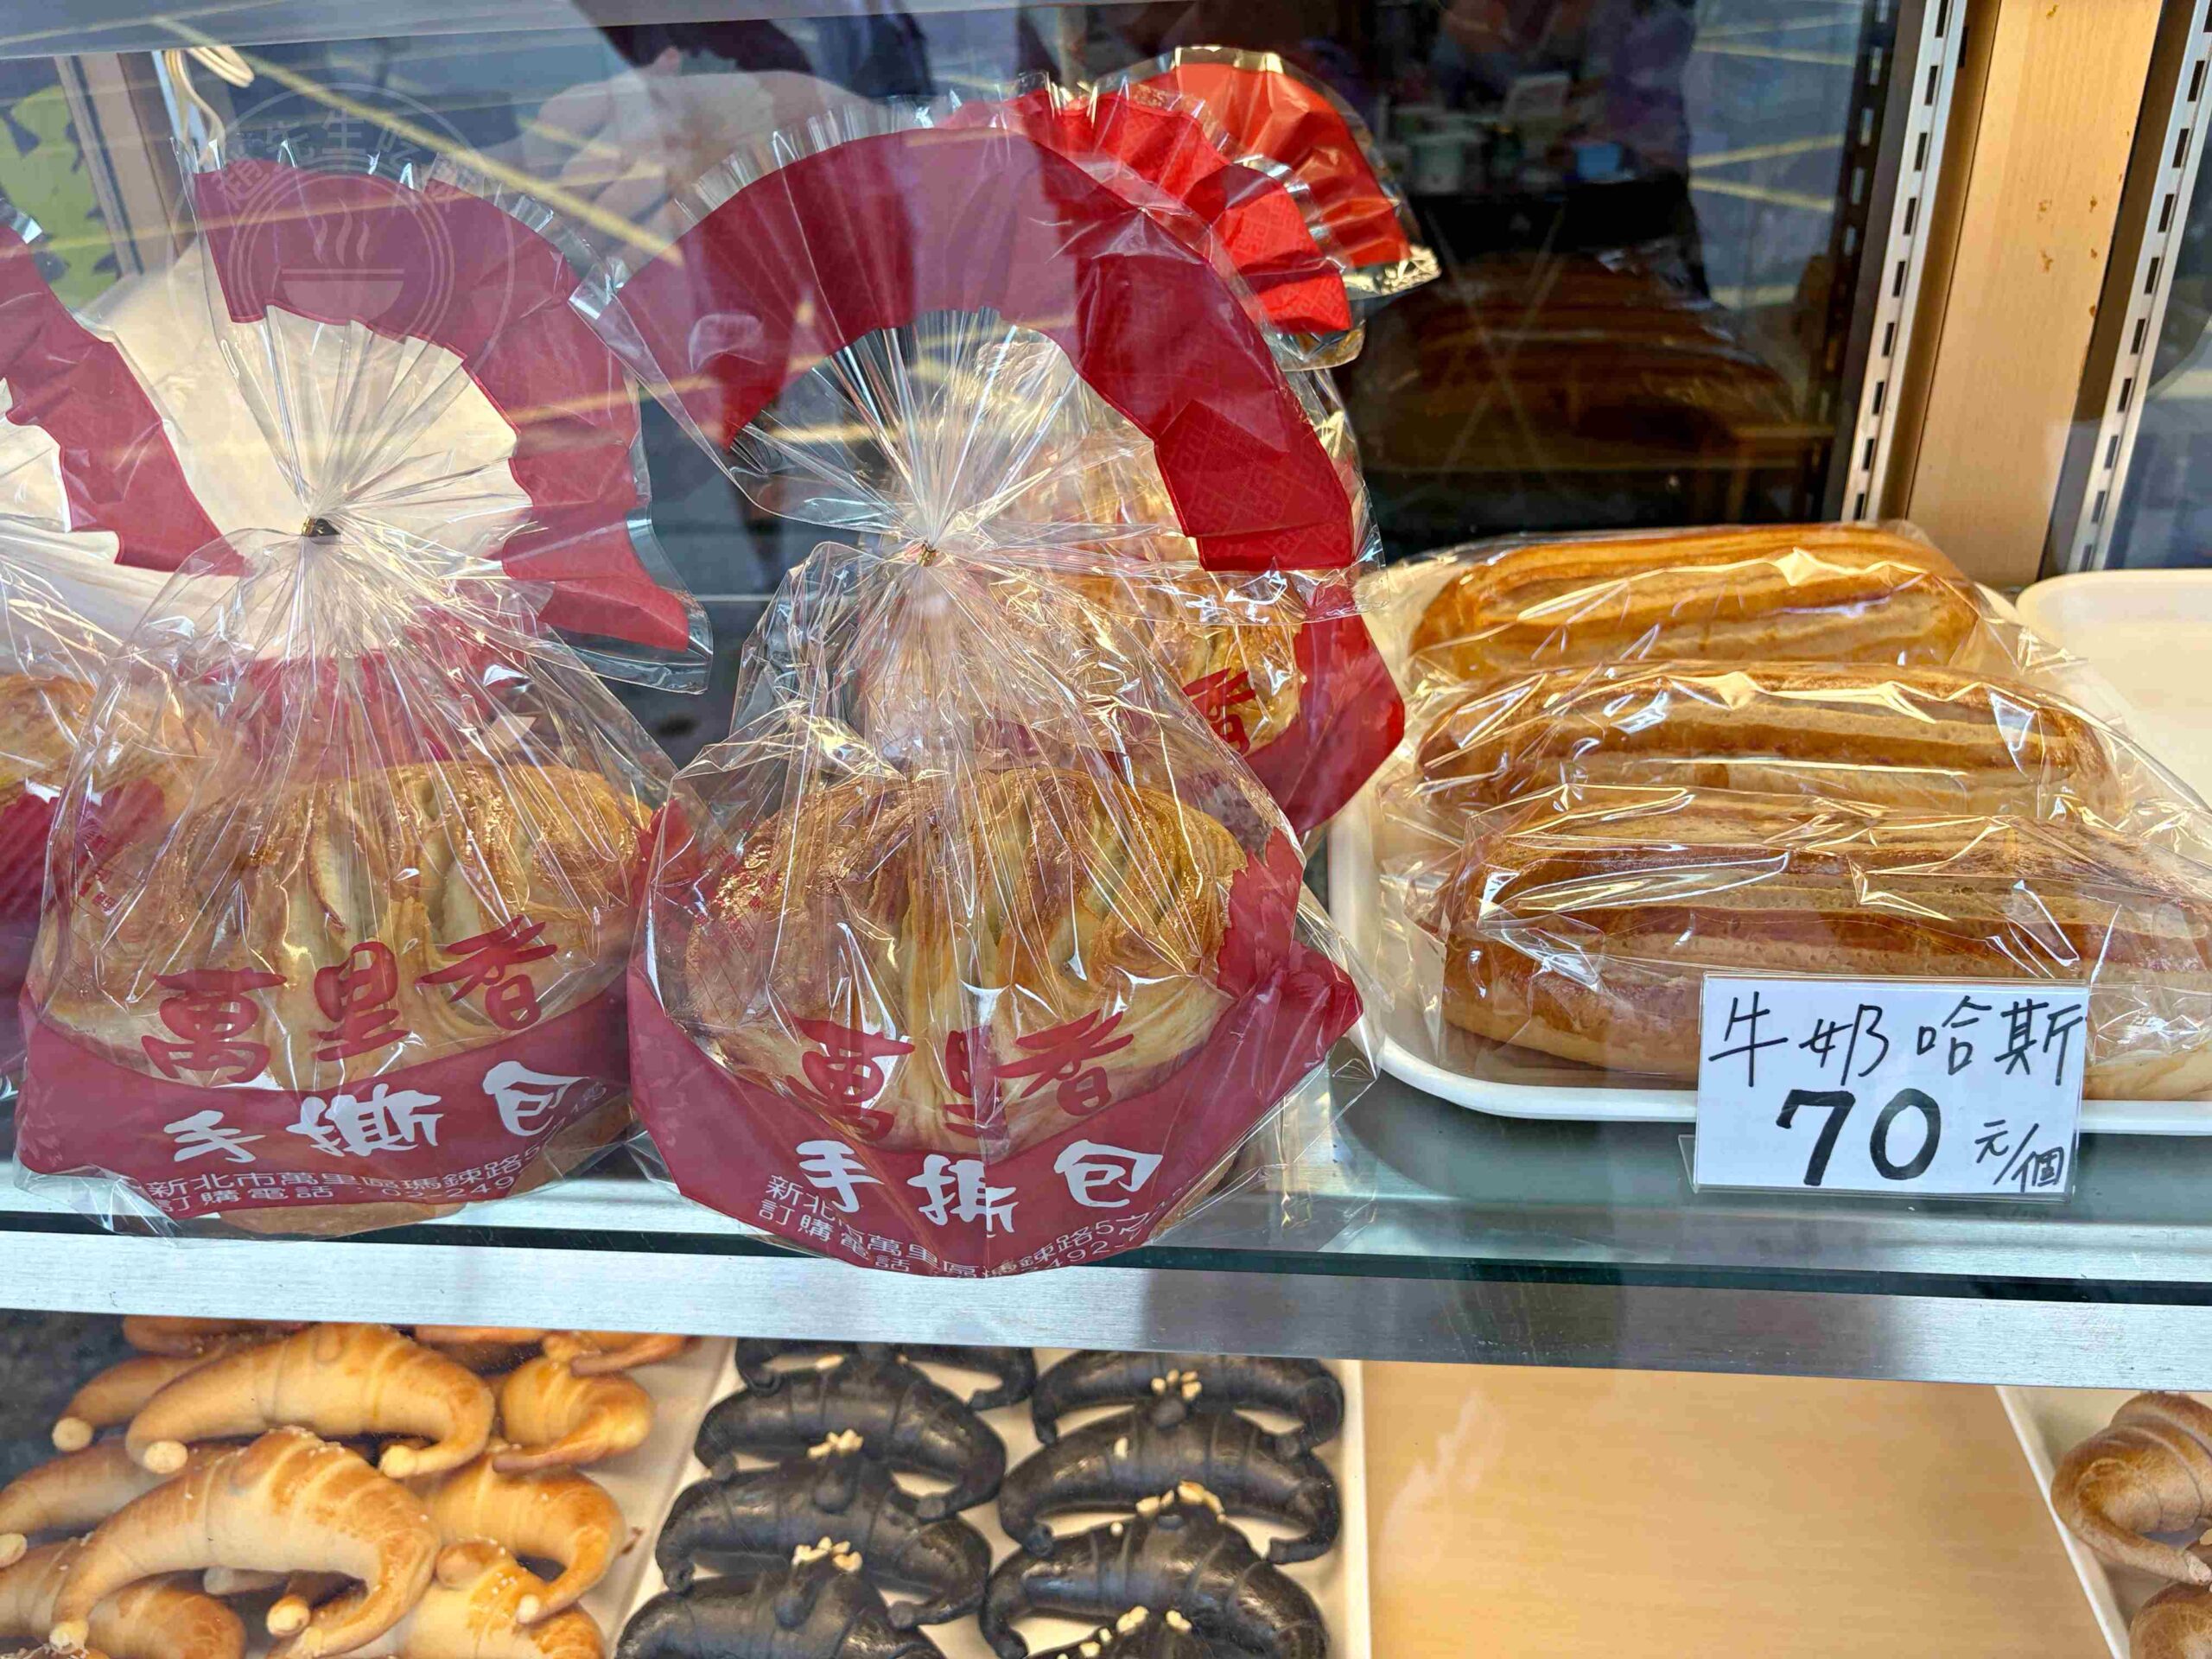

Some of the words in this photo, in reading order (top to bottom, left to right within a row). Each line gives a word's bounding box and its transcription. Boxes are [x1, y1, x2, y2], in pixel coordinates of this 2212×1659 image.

[142, 915, 558, 1084] 萬里香
[1708, 991, 2084, 1087] 牛奶哈斯
[1776, 1088, 1942, 1186] 70
[1974, 1119, 2065, 1192] 元/個
